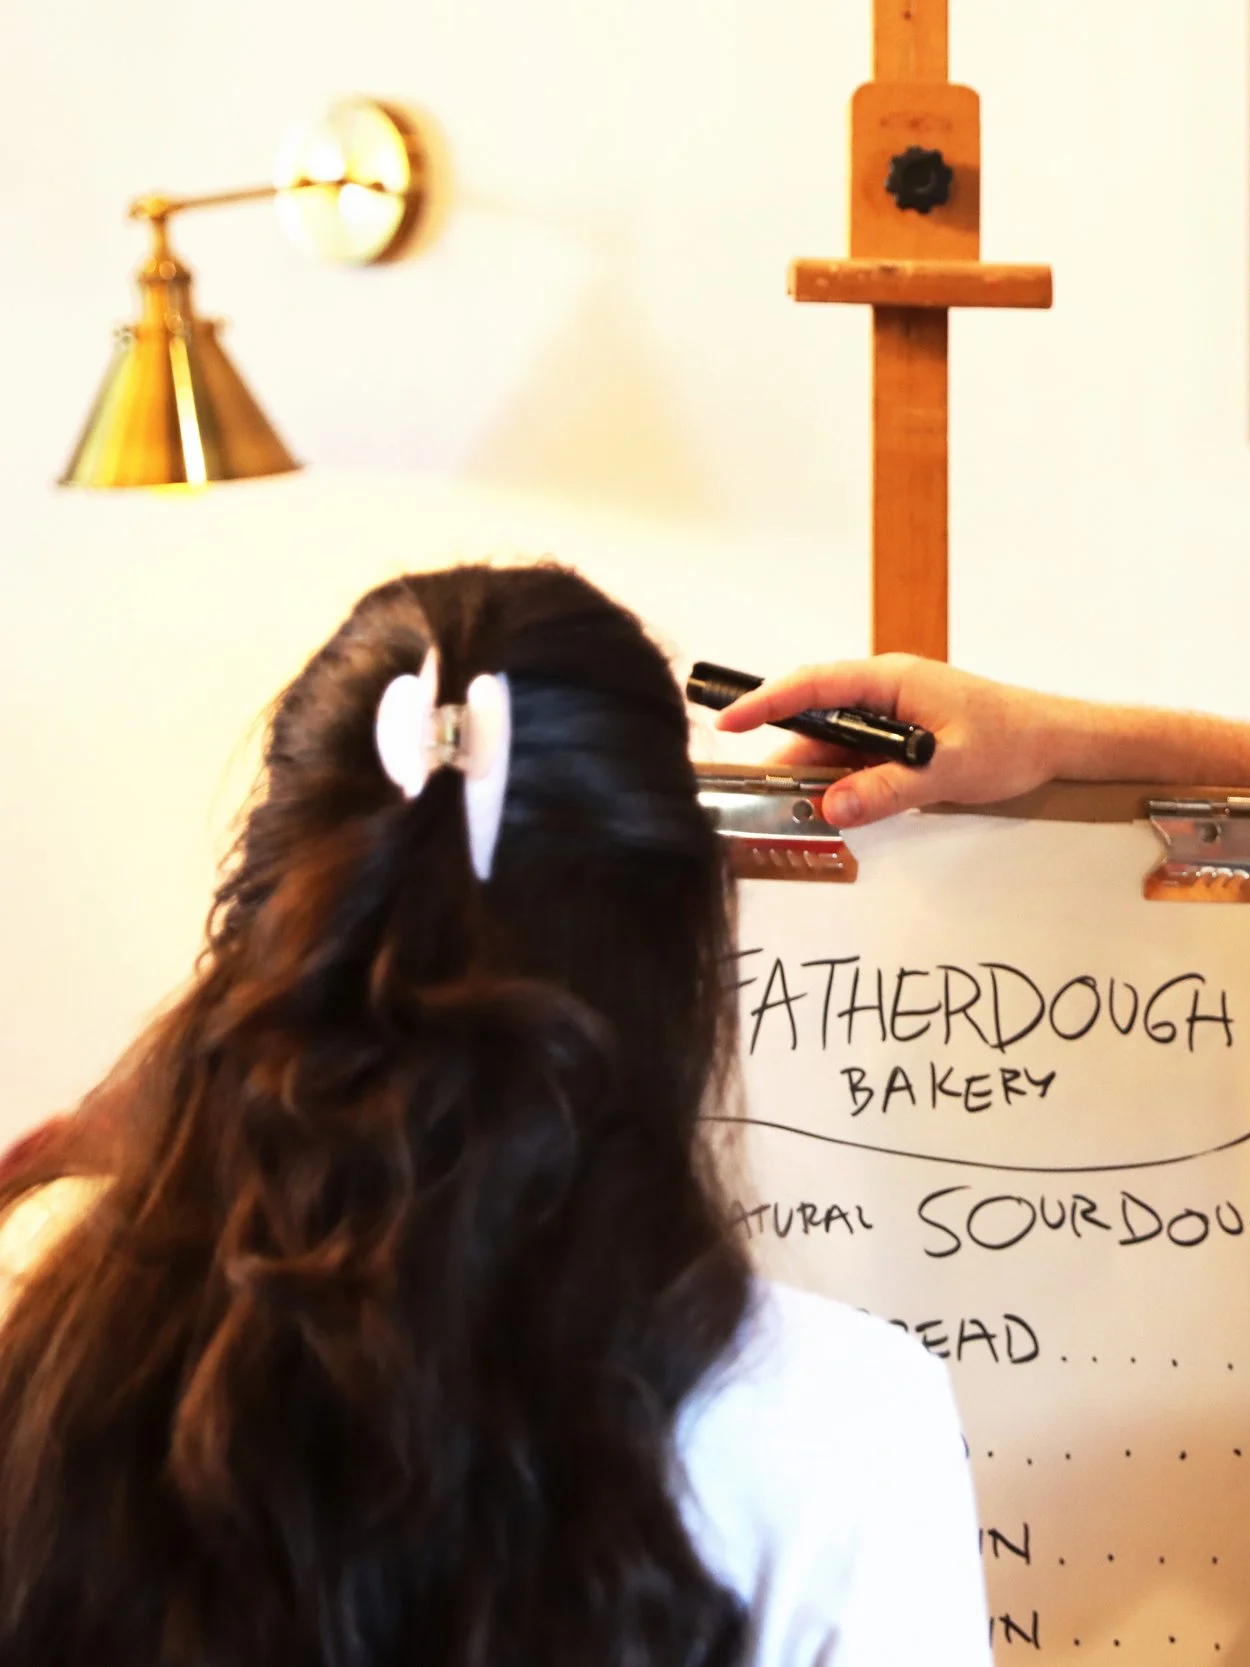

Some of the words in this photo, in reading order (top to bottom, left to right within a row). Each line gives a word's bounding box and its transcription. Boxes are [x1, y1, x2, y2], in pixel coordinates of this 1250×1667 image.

[840, 1060, 1058, 1117] BAKERY
[724, 1199, 875, 1240] ATURAL
[888, 1312, 1042, 1365] EAD
